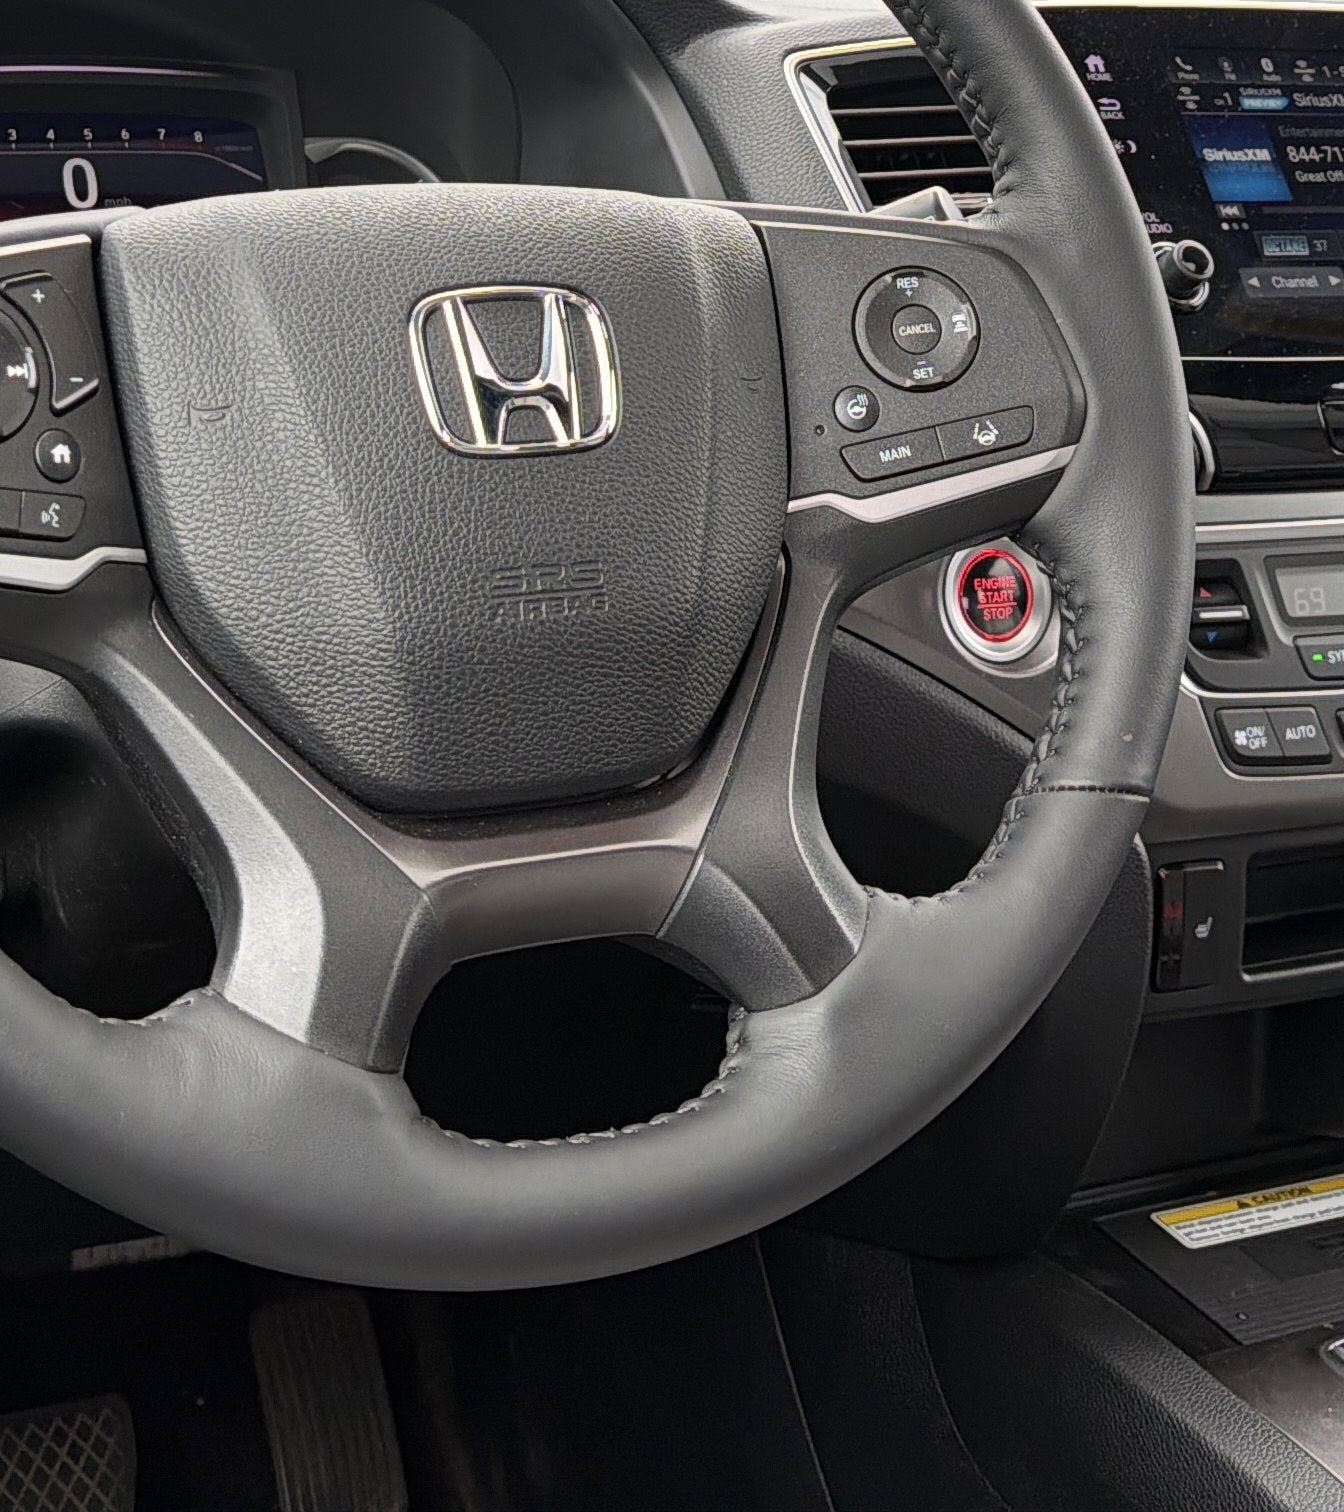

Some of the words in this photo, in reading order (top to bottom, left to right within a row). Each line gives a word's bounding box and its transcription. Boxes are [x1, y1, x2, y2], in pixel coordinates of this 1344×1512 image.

[1085, 72, 1113, 82] HOME
[1322, 66, 1331, 78] 1
[1100, 111, 1125, 120] BACK
[8, 128, 17, 141] 3
[46, 128, 55, 140] 4
[83, 128, 93, 140] 5
[120, 128, 130, 140] 6
[157, 128, 166, 140] 7
[193, 131, 203, 143] 8
[1202, 148, 1272, 162] SiriusXM
[62, 157, 99, 209] 0
[1294, 170, 1327, 183] Great
[1142, 211, 1161, 223] OL
[1146, 222, 1174, 234] UDIO
[1313, 239, 1327, 252] 37
[896, 276, 919, 290] RES
[1271, 275, 1319, 288] Channel
[898, 322, 937, 337] CANCEL
[912, 366, 935, 380] SET
[878, 444, 912, 463] MAIN
[488, 560, 610, 591] SRS
[973, 575, 1018, 591] ENGINE
[979, 589, 1016, 604] START
[1293, 586, 1327, 615] 69
[983, 607, 1014, 622] STOP
[1246, 725, 1265, 738] ON/
[1285, 724, 1317, 741] AUTO
[1248, 736, 1268, 750] OFF
[1250, 1185, 1313, 1206] CAUTION
